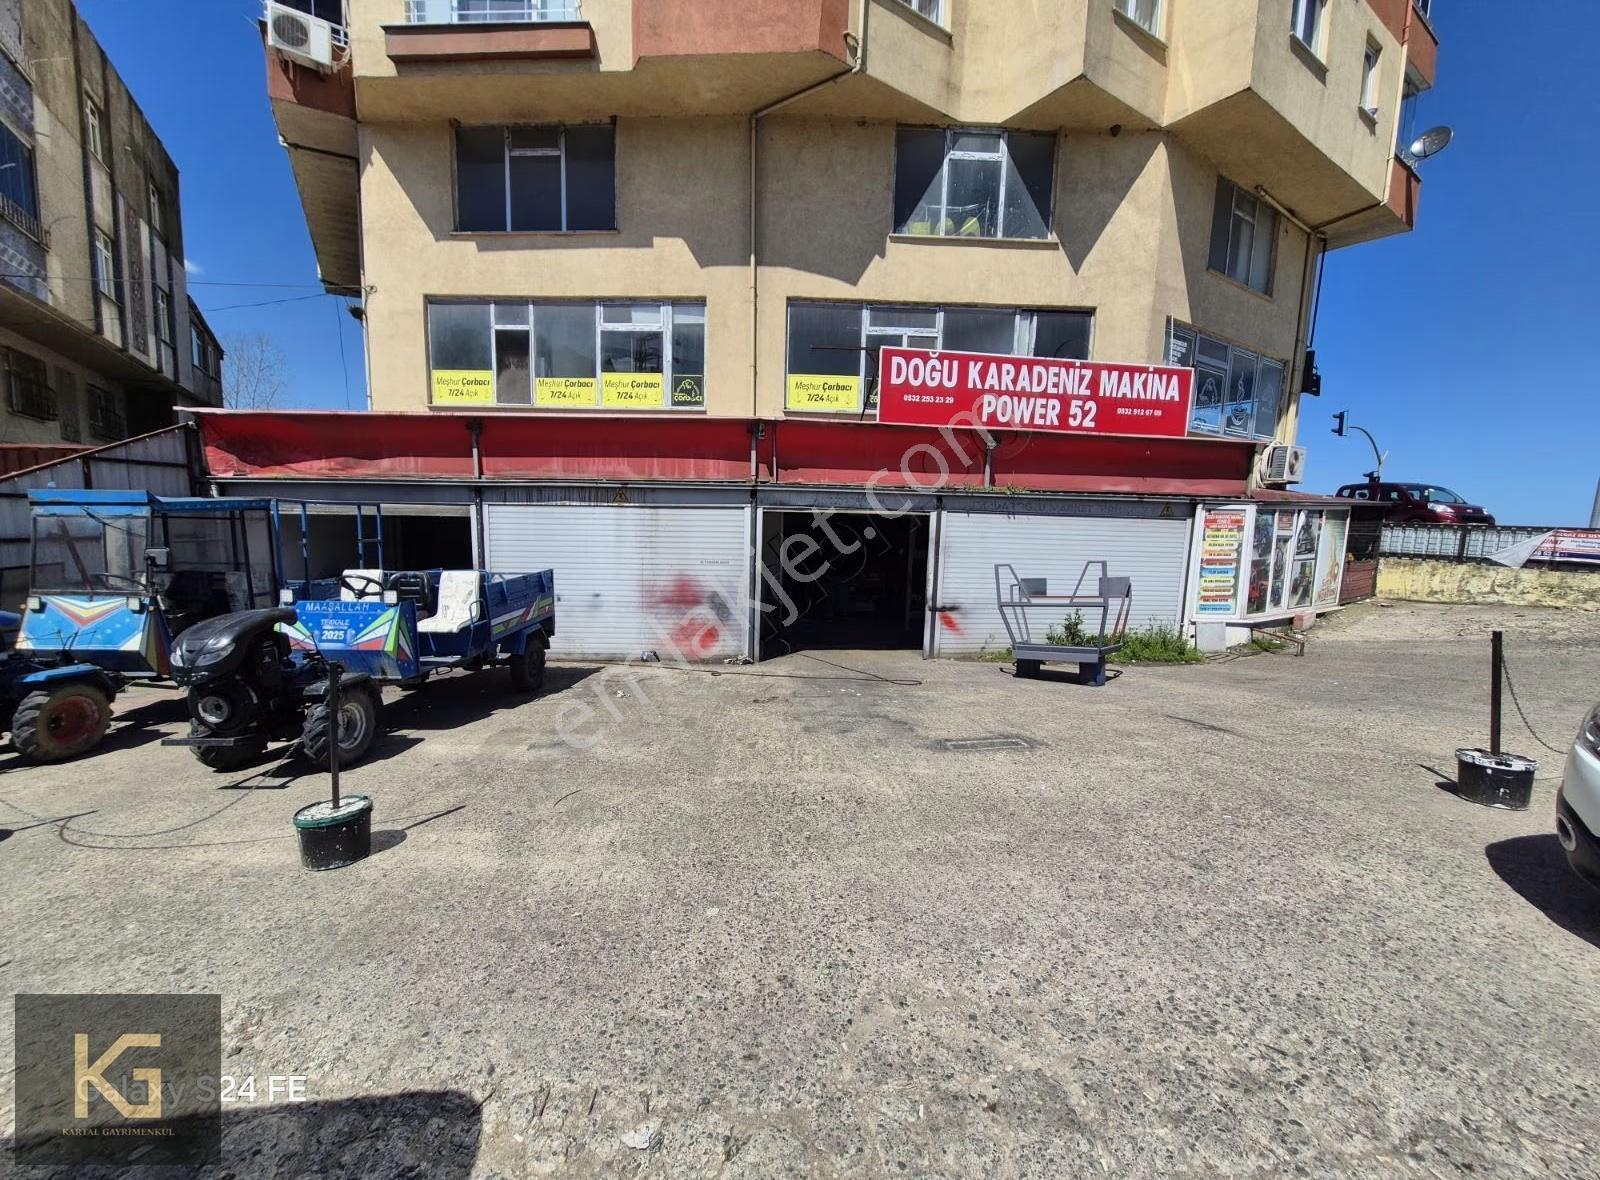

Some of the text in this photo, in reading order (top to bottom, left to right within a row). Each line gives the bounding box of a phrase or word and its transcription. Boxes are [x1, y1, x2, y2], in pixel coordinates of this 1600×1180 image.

[890, 351, 1180, 401] DOĞU KARADENİZ MAKİNA
[436, 376, 490, 387] Meşhur Çorbacı
[538, 379, 593, 389] Meşhur Çorbacı
[605, 380, 660, 390] Meşhur Çorbacı
[795, 381, 852, 393] Meşhur Çorbacı
[448, 388, 464, 397] 7/24
[550, 390, 567, 399] 7/24
[616, 391, 633, 399] 7/24
[807, 393, 825, 402] 7/24
[981, 394, 1097, 428] POWER 52
[321, 630, 345, 640] 2025
